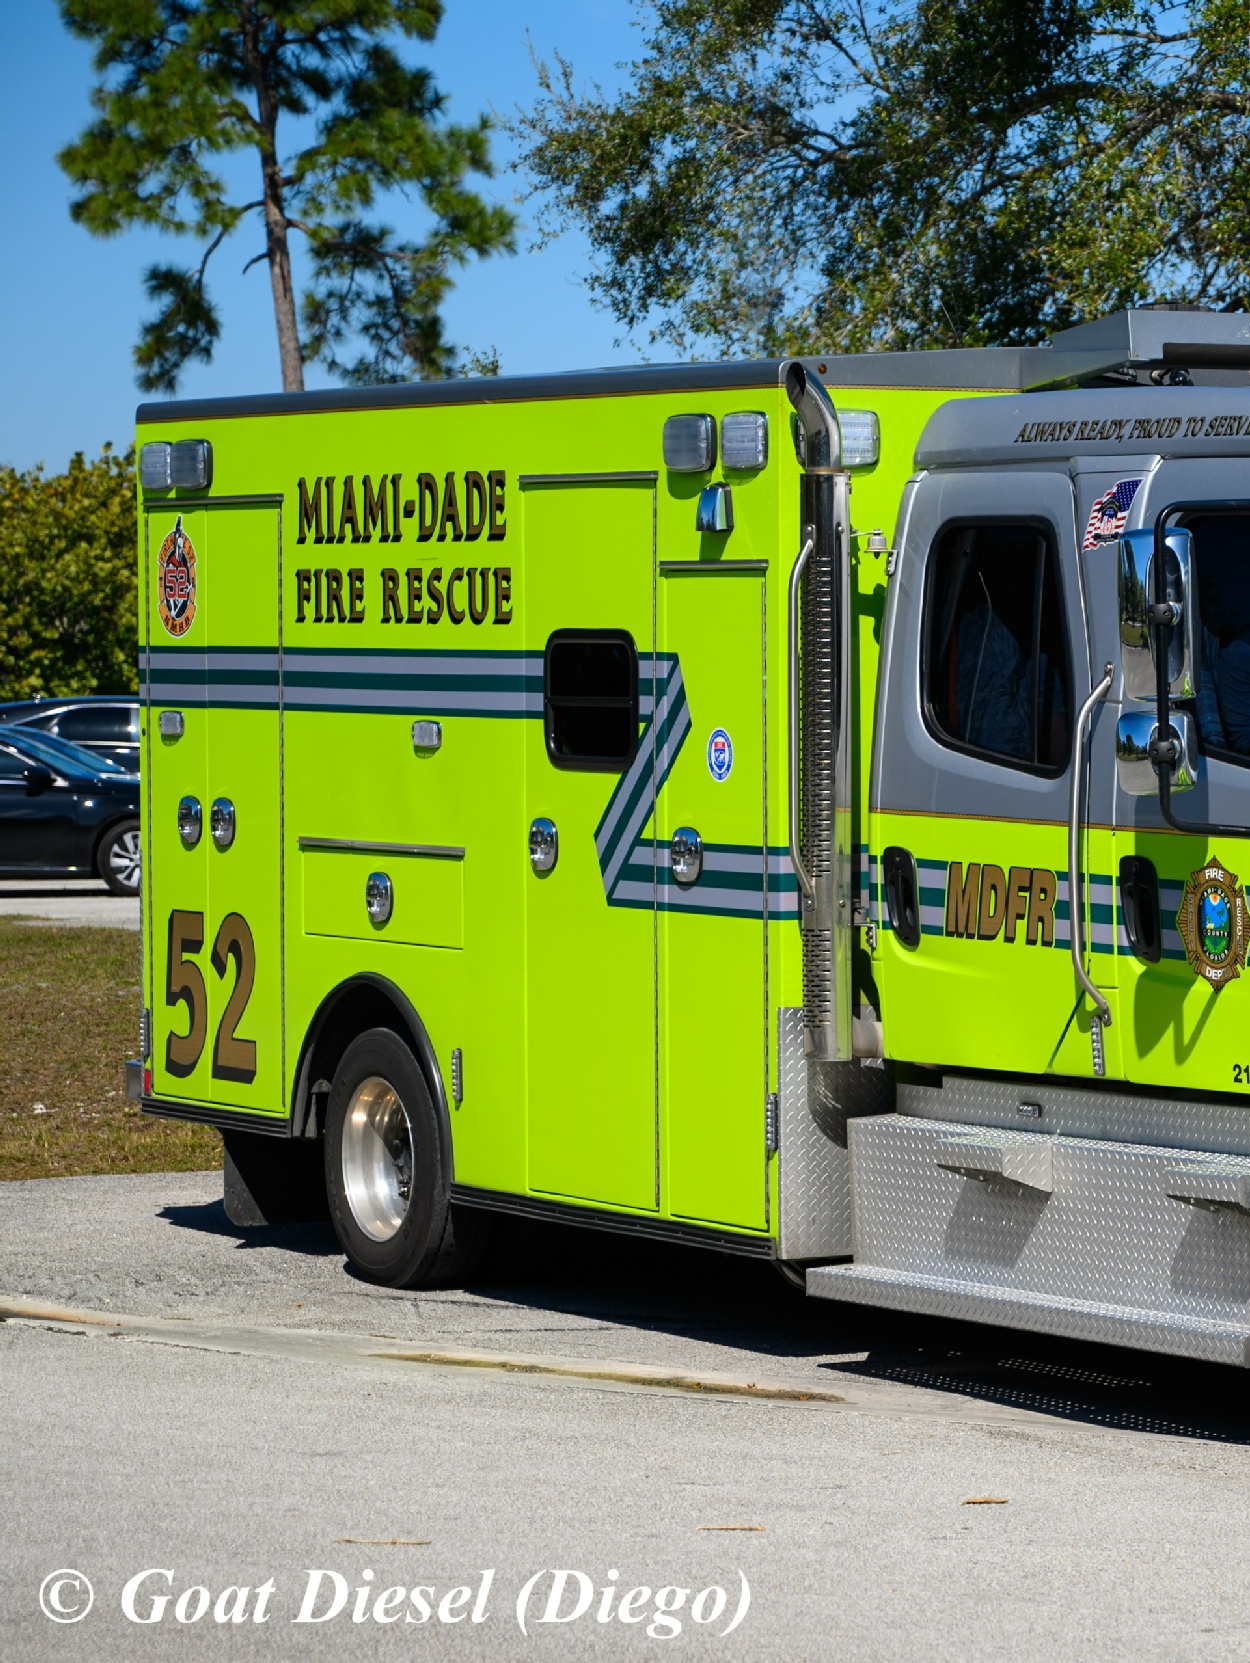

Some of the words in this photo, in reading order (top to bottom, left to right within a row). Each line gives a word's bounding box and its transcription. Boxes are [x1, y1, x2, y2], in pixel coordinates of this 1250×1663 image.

[1014, 421, 1077, 443] ALWAYS
[1074, 419, 1131, 443] READY,
[1129, 416, 1182, 439] PROUD
[1183, 416, 1206, 437] TO
[296, 470, 507, 544] MIAMI-DADE
[165, 567, 188, 600] 52
[295, 568, 365, 623] FIRE
[380, 566, 513, 625] RESCUE
[945, 861, 1057, 948] MDFR
[1205, 868, 1224, 882] FIRE
[165, 909, 257, 1084] 52
